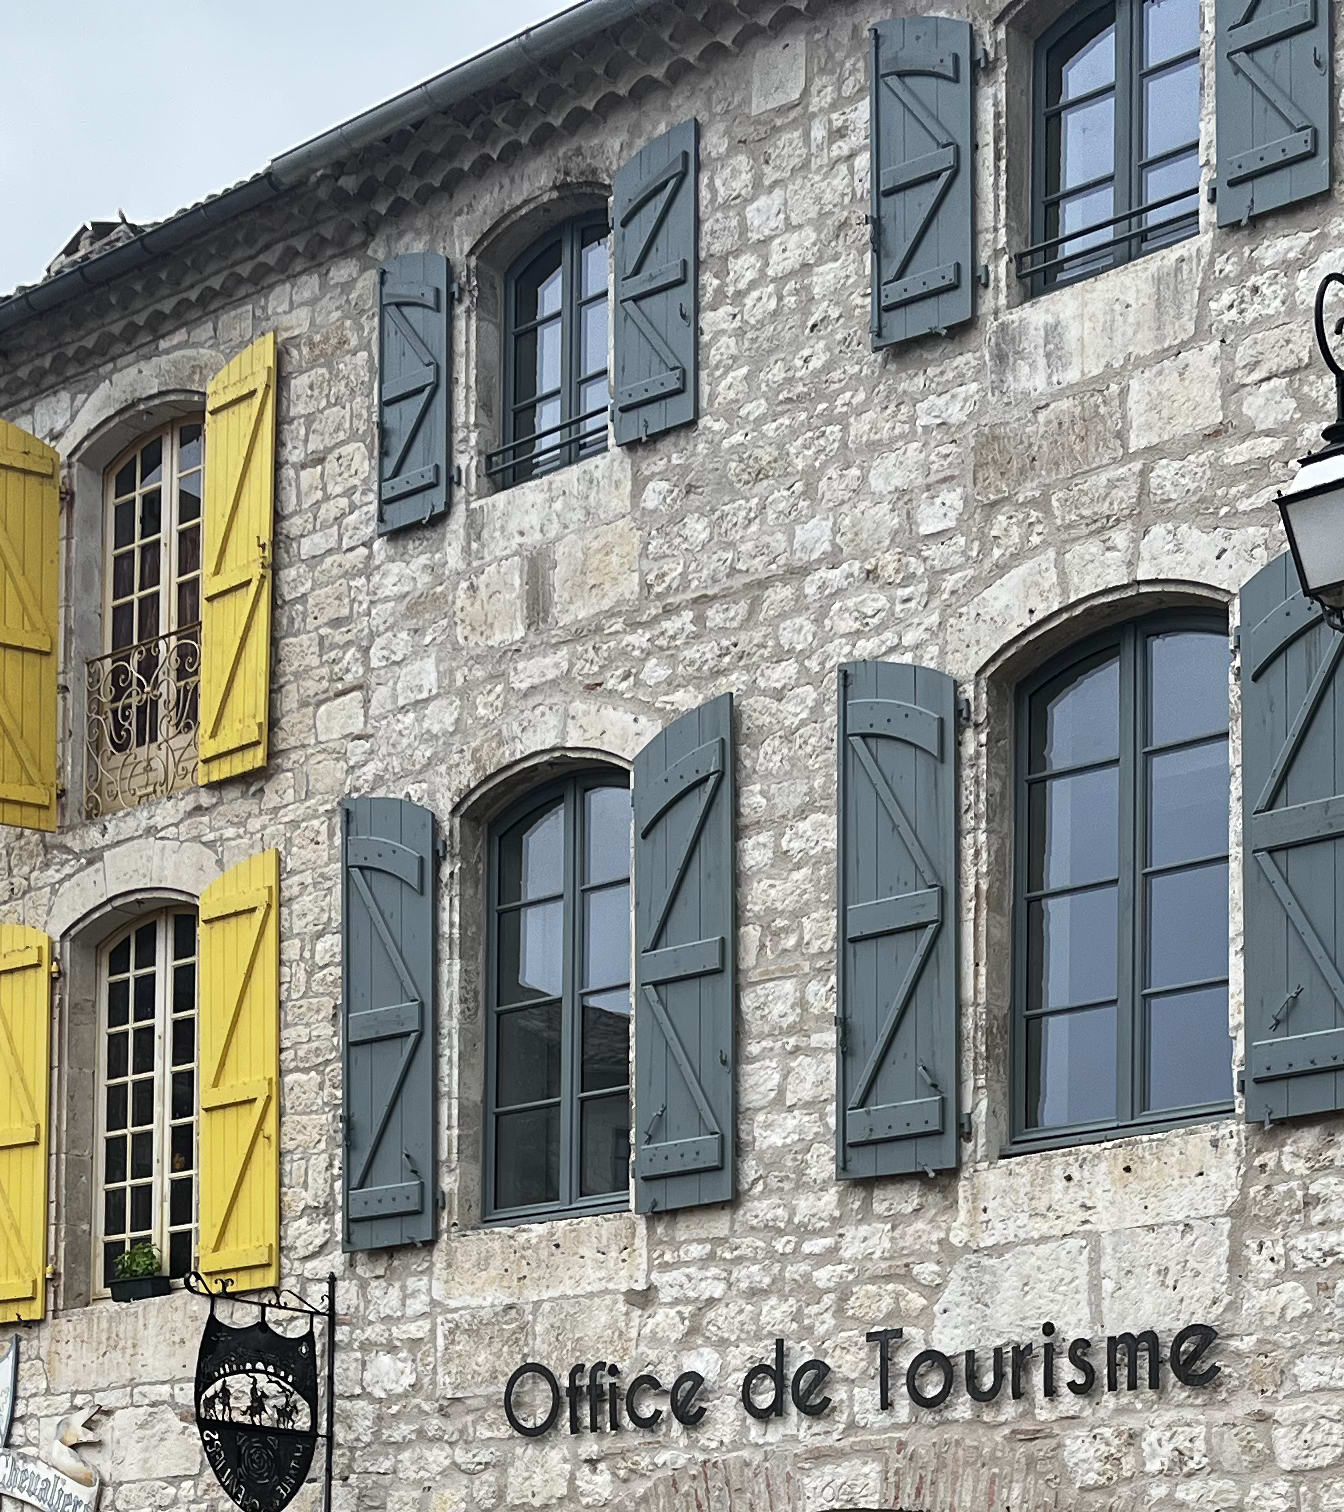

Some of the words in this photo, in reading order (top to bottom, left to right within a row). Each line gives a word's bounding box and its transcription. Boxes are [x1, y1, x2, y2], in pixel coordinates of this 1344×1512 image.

[504, 1361, 707, 1437] Office
[740, 1338, 833, 1421] de
[865, 1322, 1222, 1411] Tourisme
